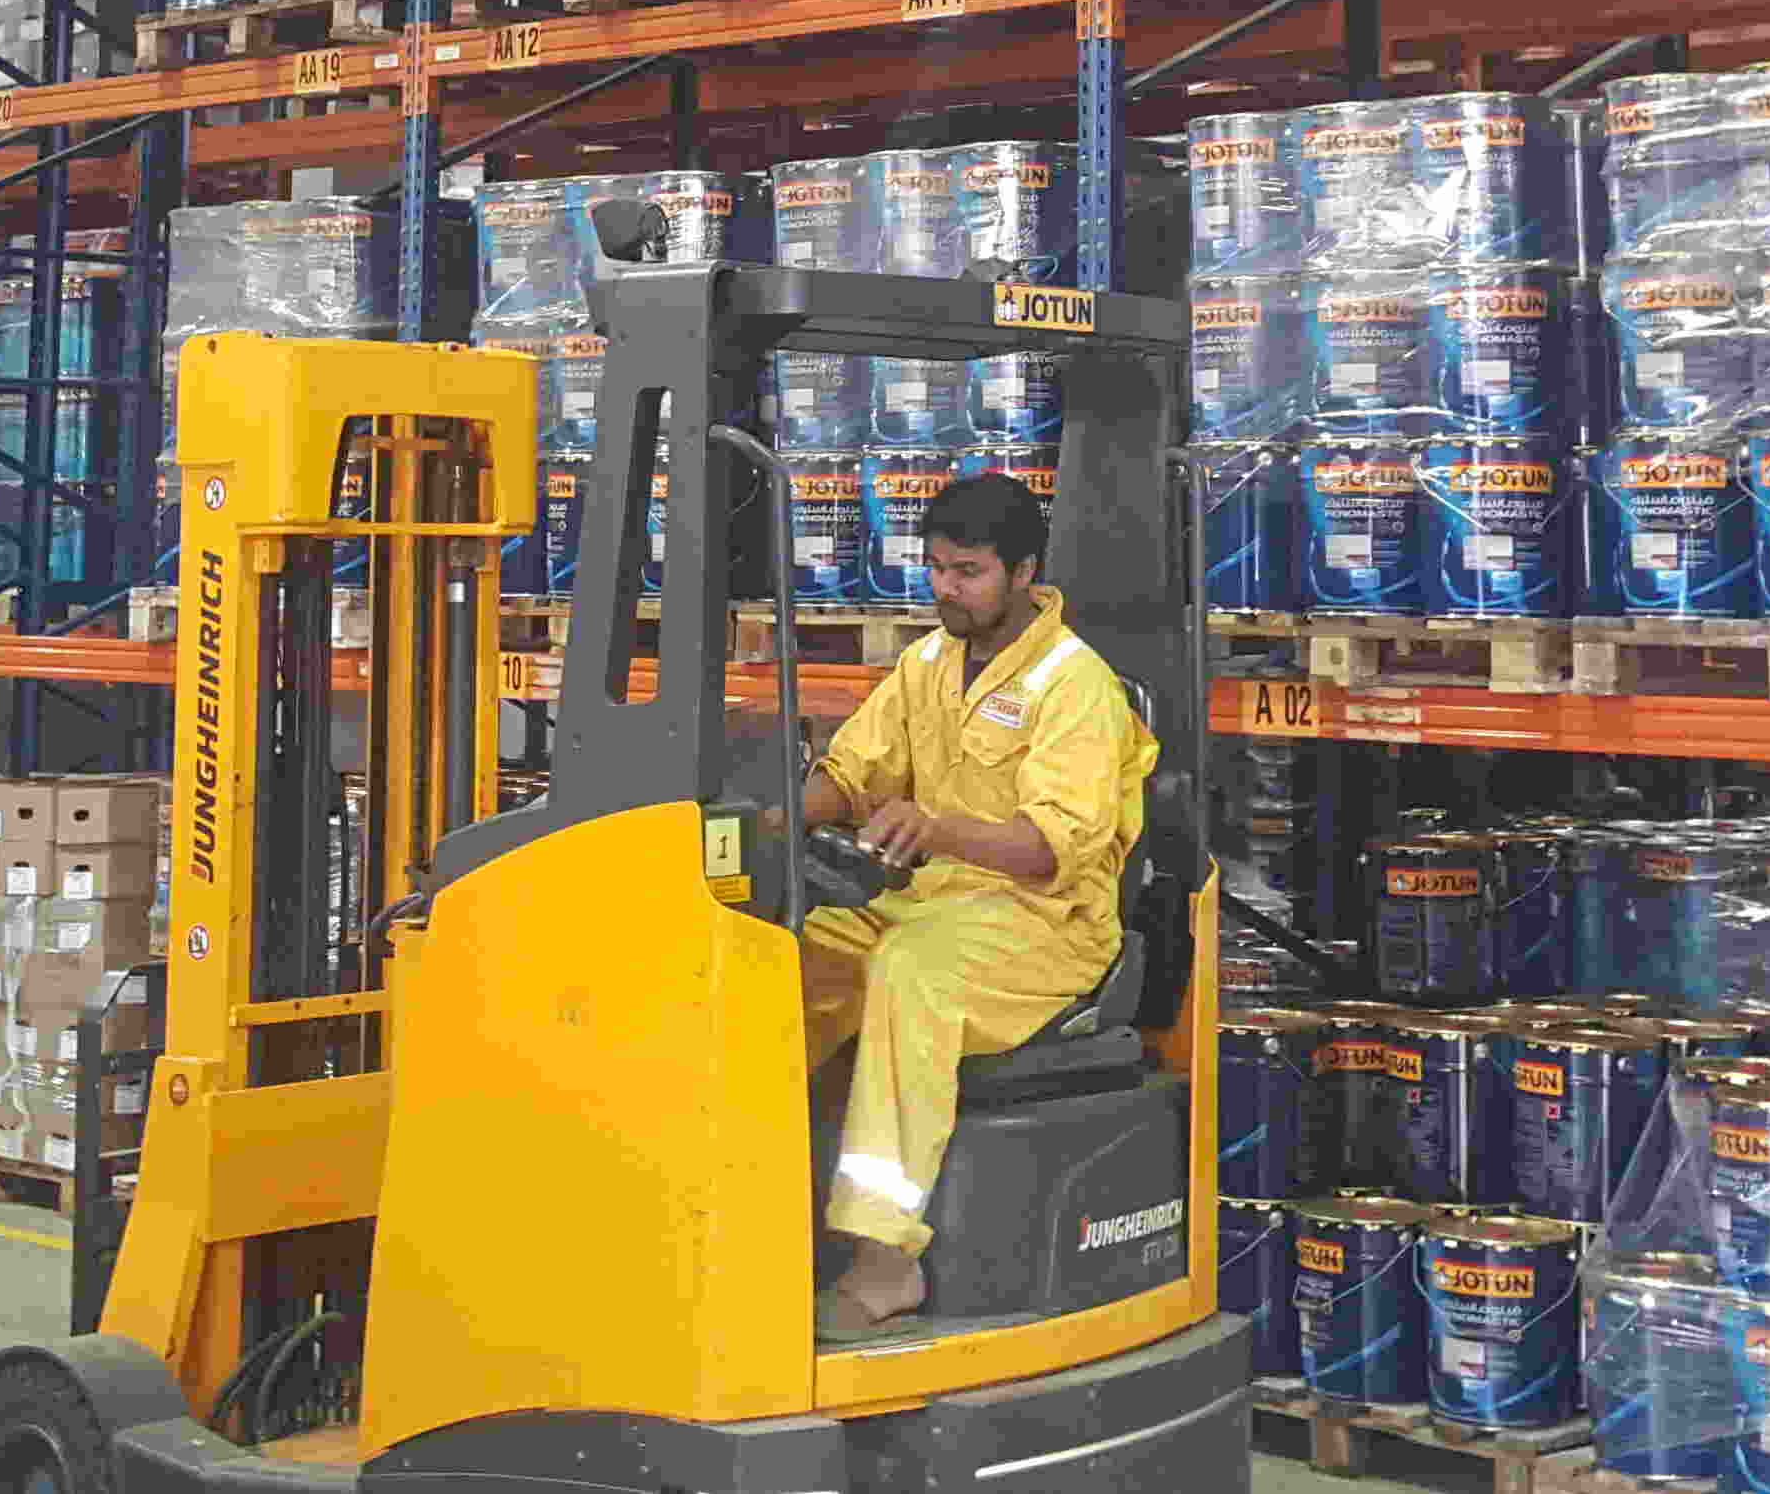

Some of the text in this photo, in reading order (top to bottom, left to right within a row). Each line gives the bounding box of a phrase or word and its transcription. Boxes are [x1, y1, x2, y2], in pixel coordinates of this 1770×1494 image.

[494, 26, 540, 63] AA12
[299, 51, 341, 85] AA19
[1021, 292, 1092, 326] JOTUN
[804, 478, 859, 497] JOTU
[1475, 468, 1550, 491] JOTUN
[1640, 461, 1721, 487] JOTUN
[190, 552, 226, 884] JUNGHEINRICH
[1255, 684, 1313, 727] A 02
[1077, 1199, 1183, 1252] JUNGHEINRICH
[1454, 1268, 1530, 1295] JOTUN
